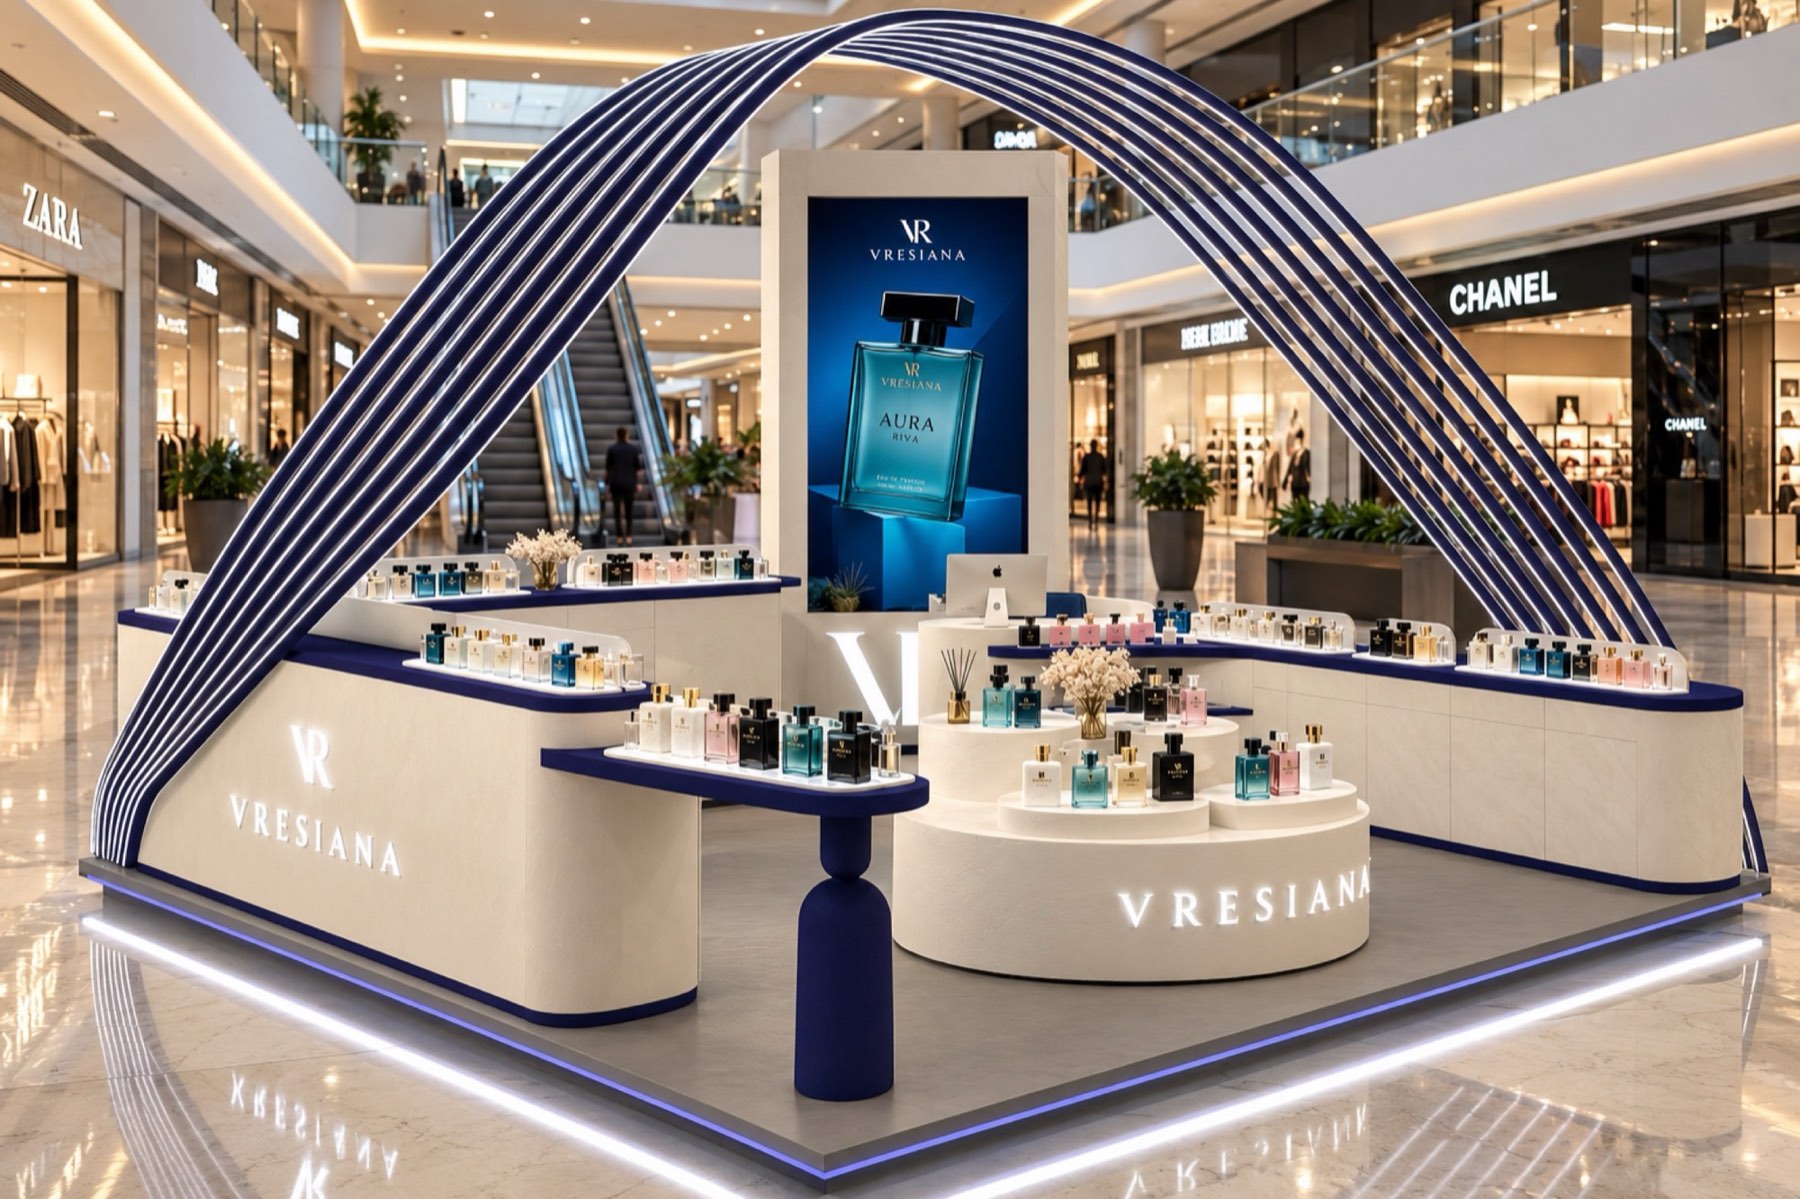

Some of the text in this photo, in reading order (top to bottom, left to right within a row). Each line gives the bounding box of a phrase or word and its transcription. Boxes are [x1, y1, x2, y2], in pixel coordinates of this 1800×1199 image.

[23, 182, 82, 250] ZARA
[870, 248, 965, 261] VRESIANA
[1449, 270, 1557, 315] CHANEL
[881, 376, 942, 391] VRESIANA
[879, 412, 934, 432] AURA
[1664, 416, 1707, 431] CHANEL
[892, 432, 919, 444] RIVA
[229, 794, 402, 877] VRESIANA
[1117, 864, 1371, 928] VRESIANA
